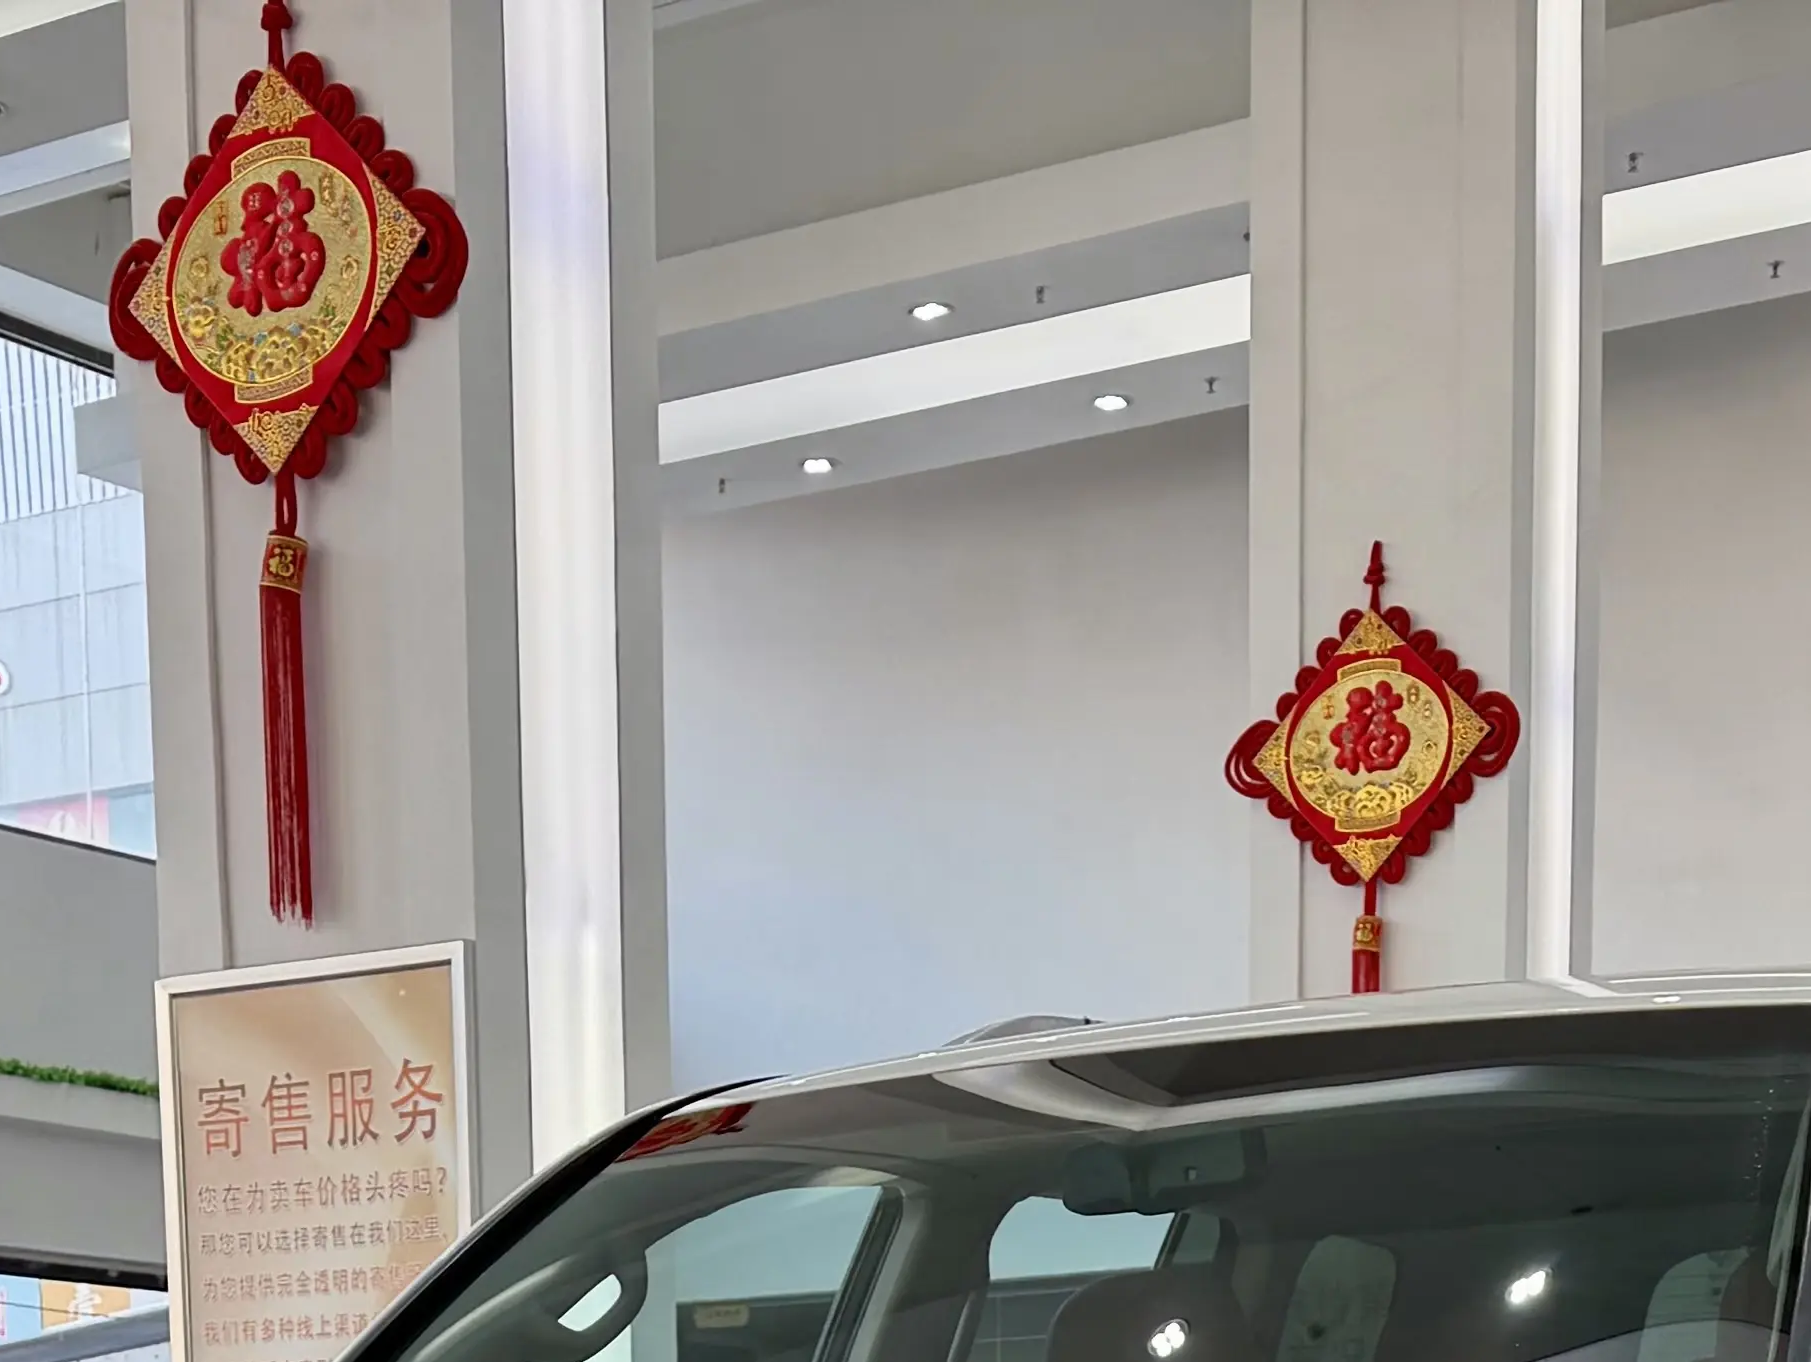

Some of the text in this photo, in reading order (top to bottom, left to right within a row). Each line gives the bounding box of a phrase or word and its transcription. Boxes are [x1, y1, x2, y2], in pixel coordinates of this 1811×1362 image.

[220, 169, 326, 317] 福
[1329, 680, 1411, 776] 福
[197, 1057, 444, 1158] 寄售服务
[203, 1310, 379, 1345] 我们有多种线上渠道
